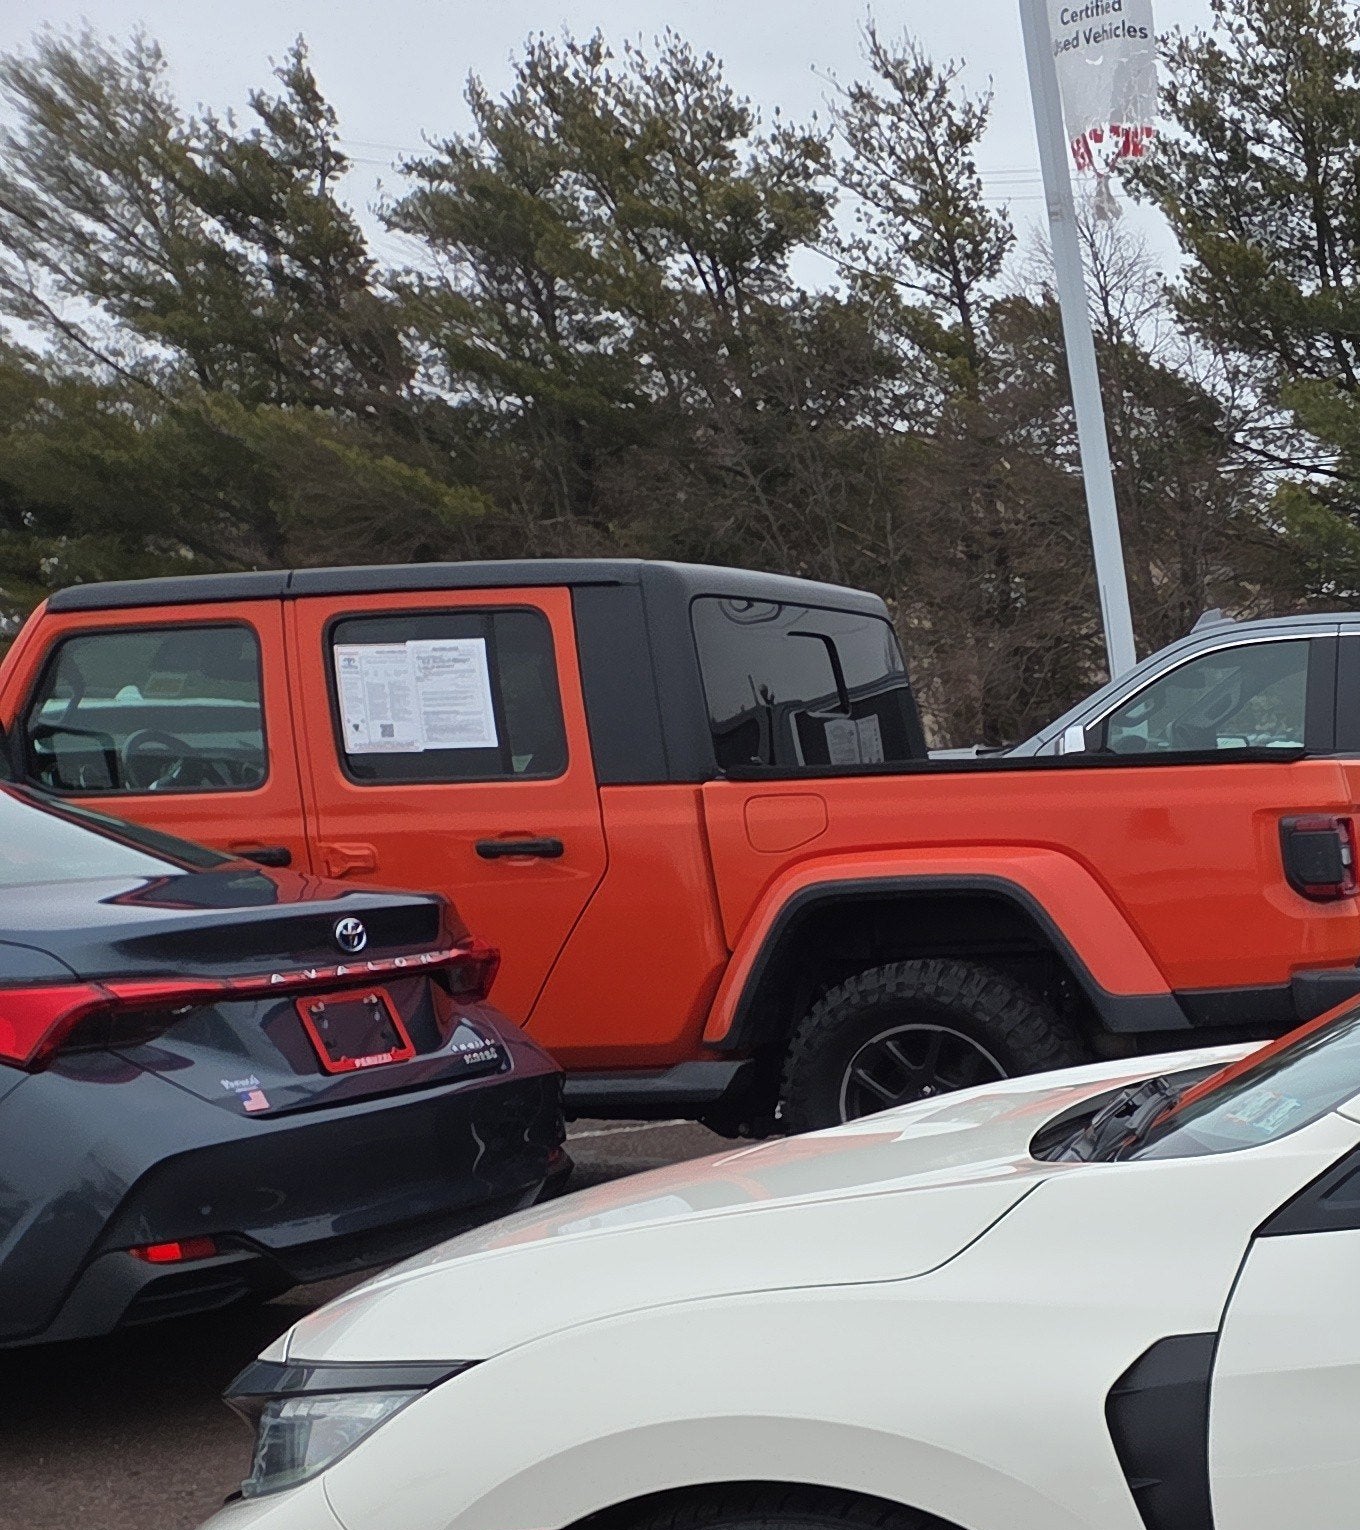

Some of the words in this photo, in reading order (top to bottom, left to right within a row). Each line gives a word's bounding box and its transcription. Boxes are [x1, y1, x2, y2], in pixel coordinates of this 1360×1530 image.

[1061, 0, 1122, 25] Certified
[1083, 20, 1148, 44] Vehicles
[271, 951, 434, 984] AVALON
